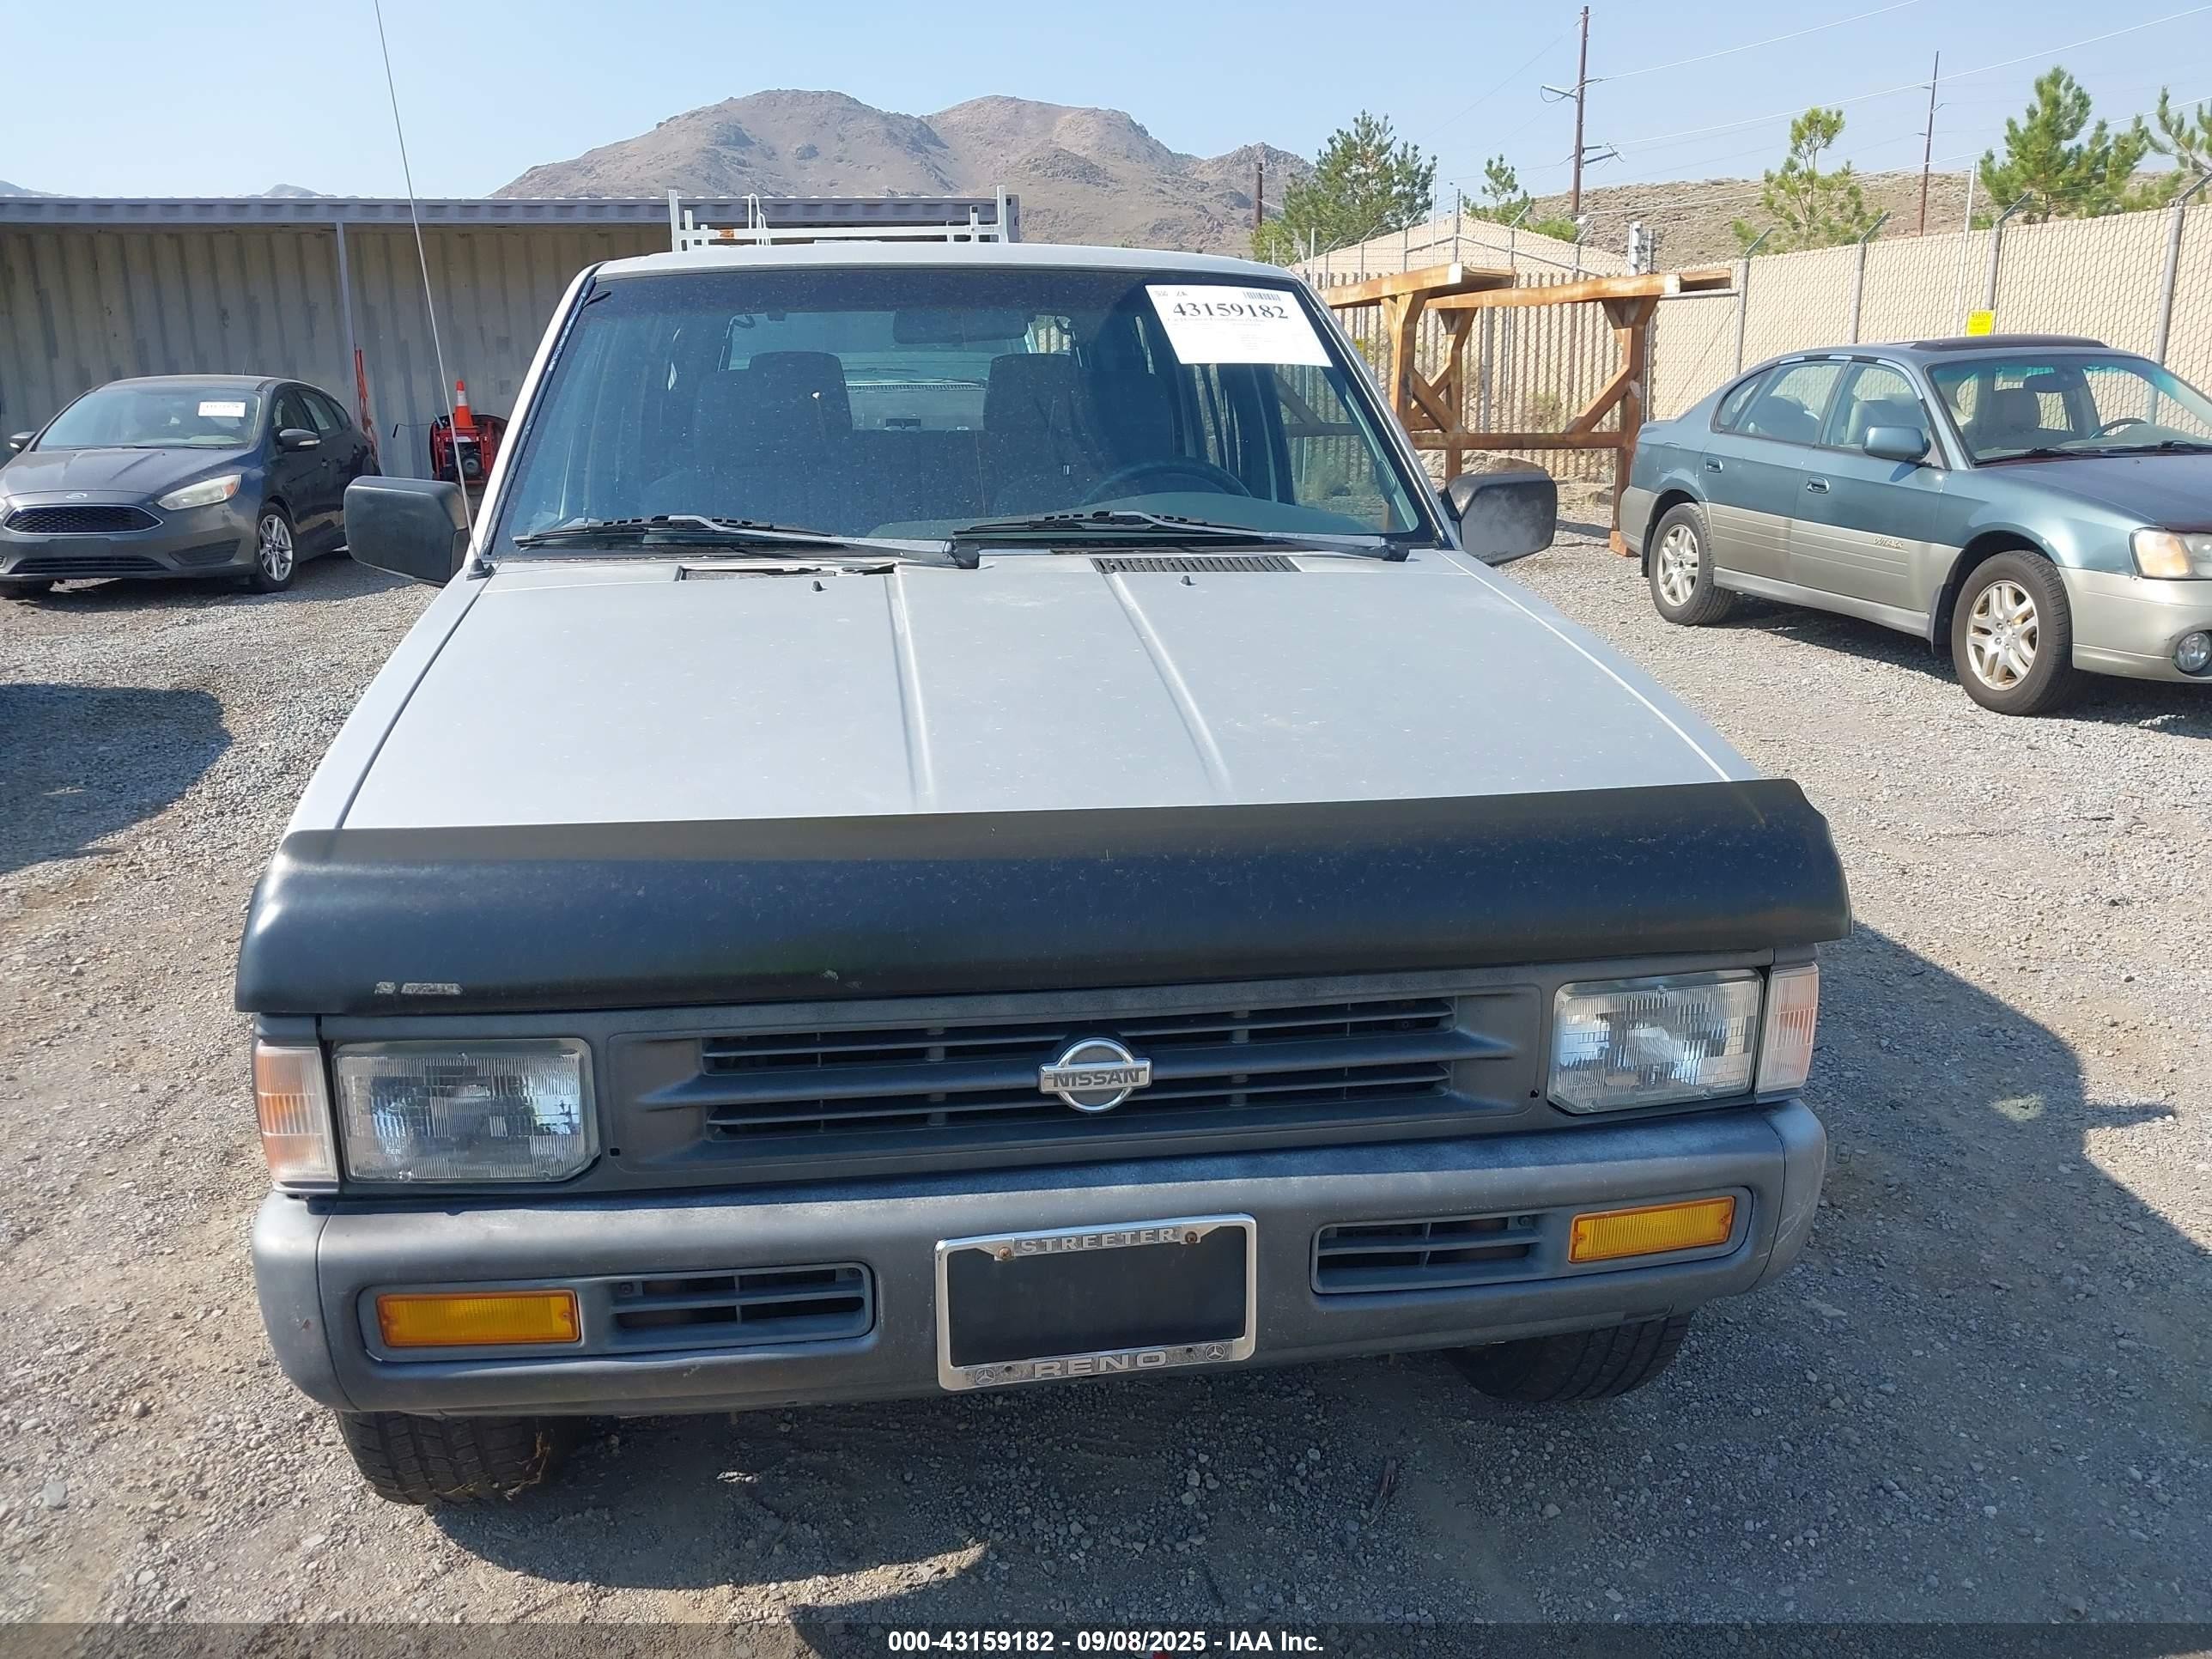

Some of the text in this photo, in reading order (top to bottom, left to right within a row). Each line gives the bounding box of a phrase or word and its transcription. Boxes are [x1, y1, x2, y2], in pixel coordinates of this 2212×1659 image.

[1173, 302, 1289, 319] 43159182
[1044, 1067, 1147, 1088] NISSAN
[1019, 1228, 1176, 1253] STREETER
[1034, 1351, 1167, 1379] RENO
